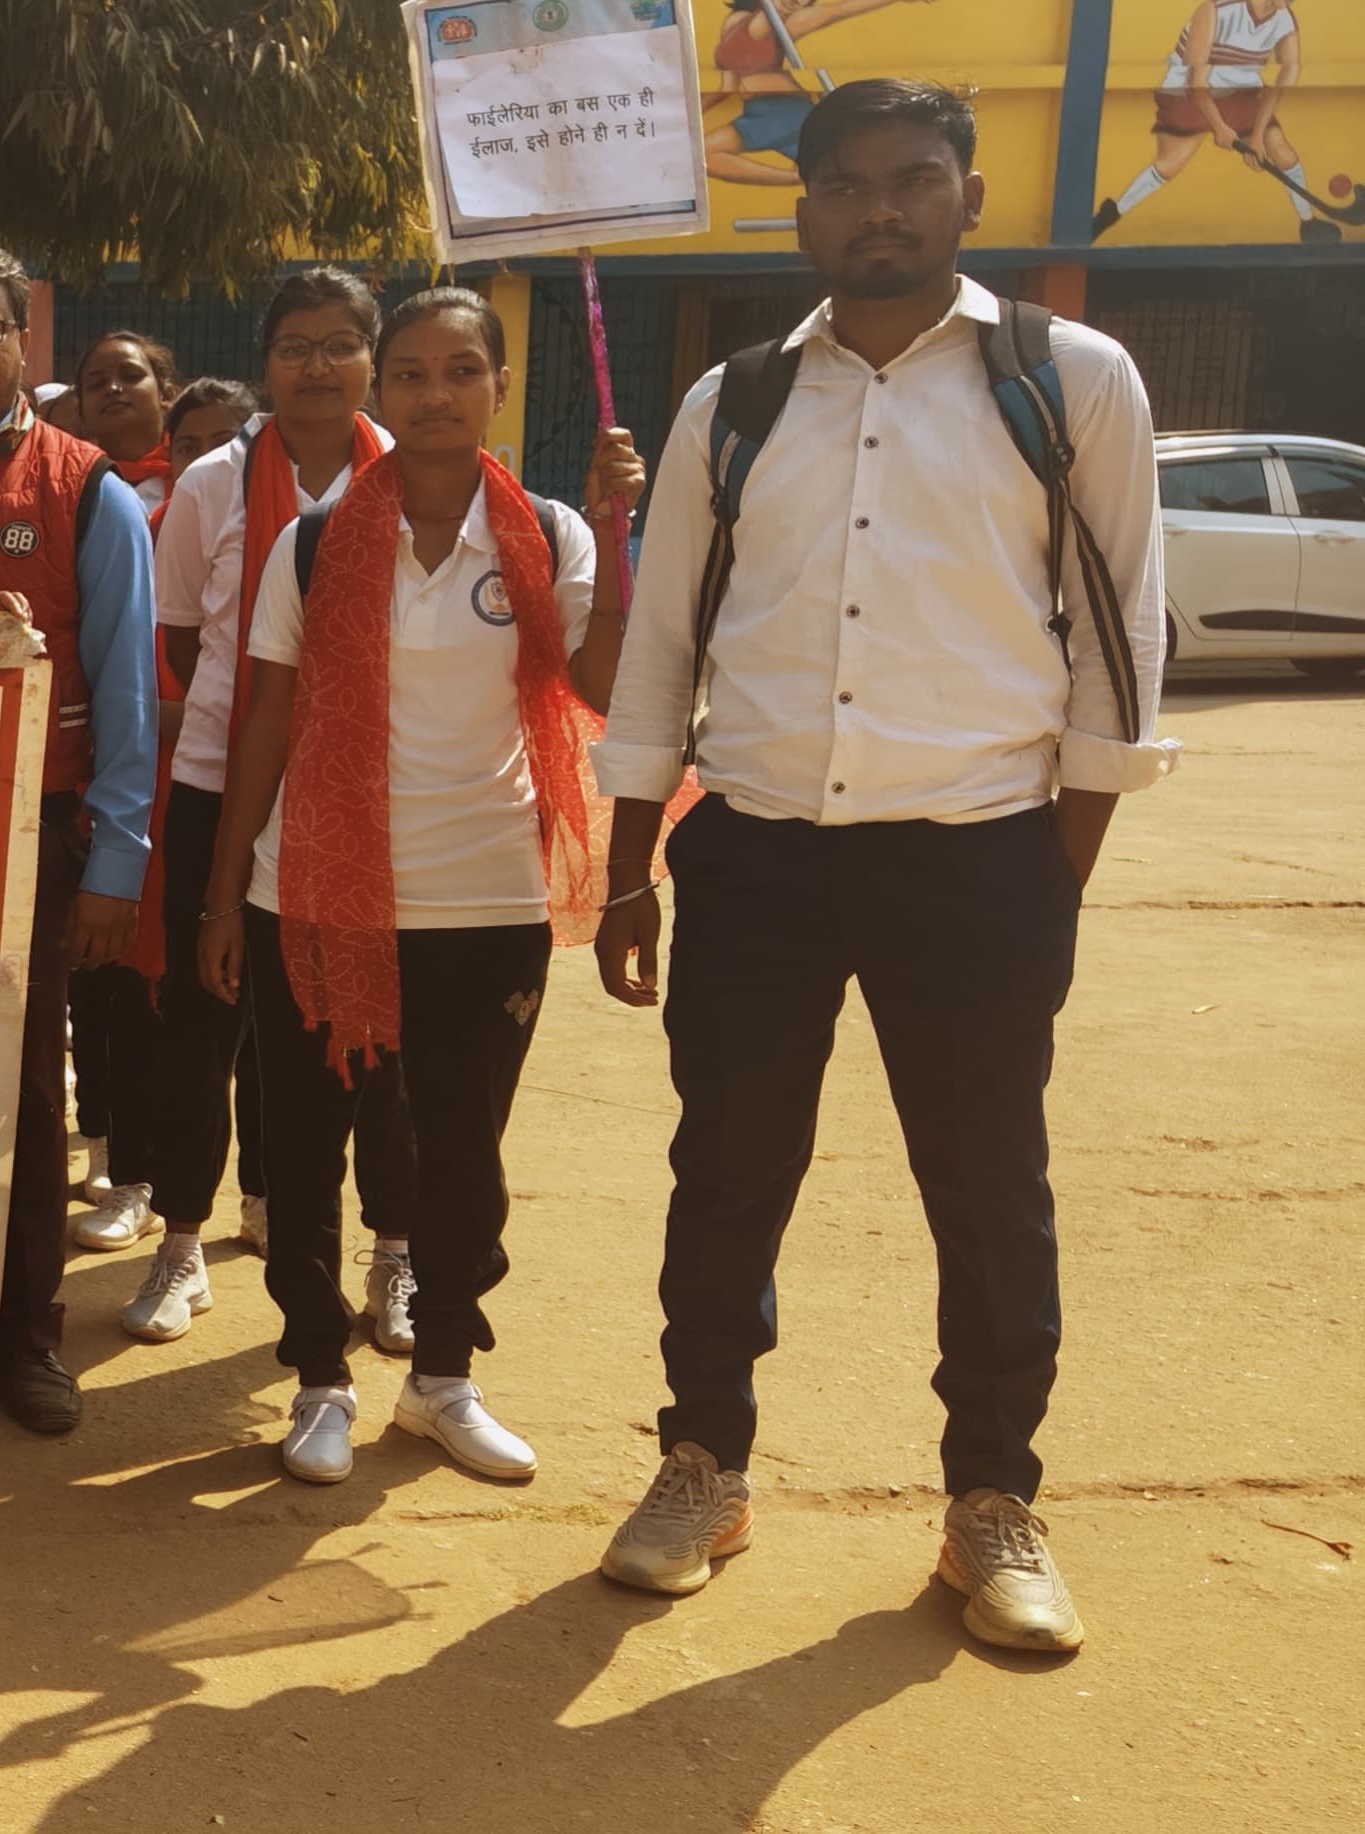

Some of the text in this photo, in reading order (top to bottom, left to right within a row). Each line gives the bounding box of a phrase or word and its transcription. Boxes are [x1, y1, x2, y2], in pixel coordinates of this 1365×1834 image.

[466, 86, 655, 128] फाईलेरिया का बस एक ही
[525, 128, 550, 153] इसे
[558, 124, 586, 147] होने
[592, 121, 609, 142] ही
[616, 124, 628, 140] न
[4, 528, 34, 551] 88
